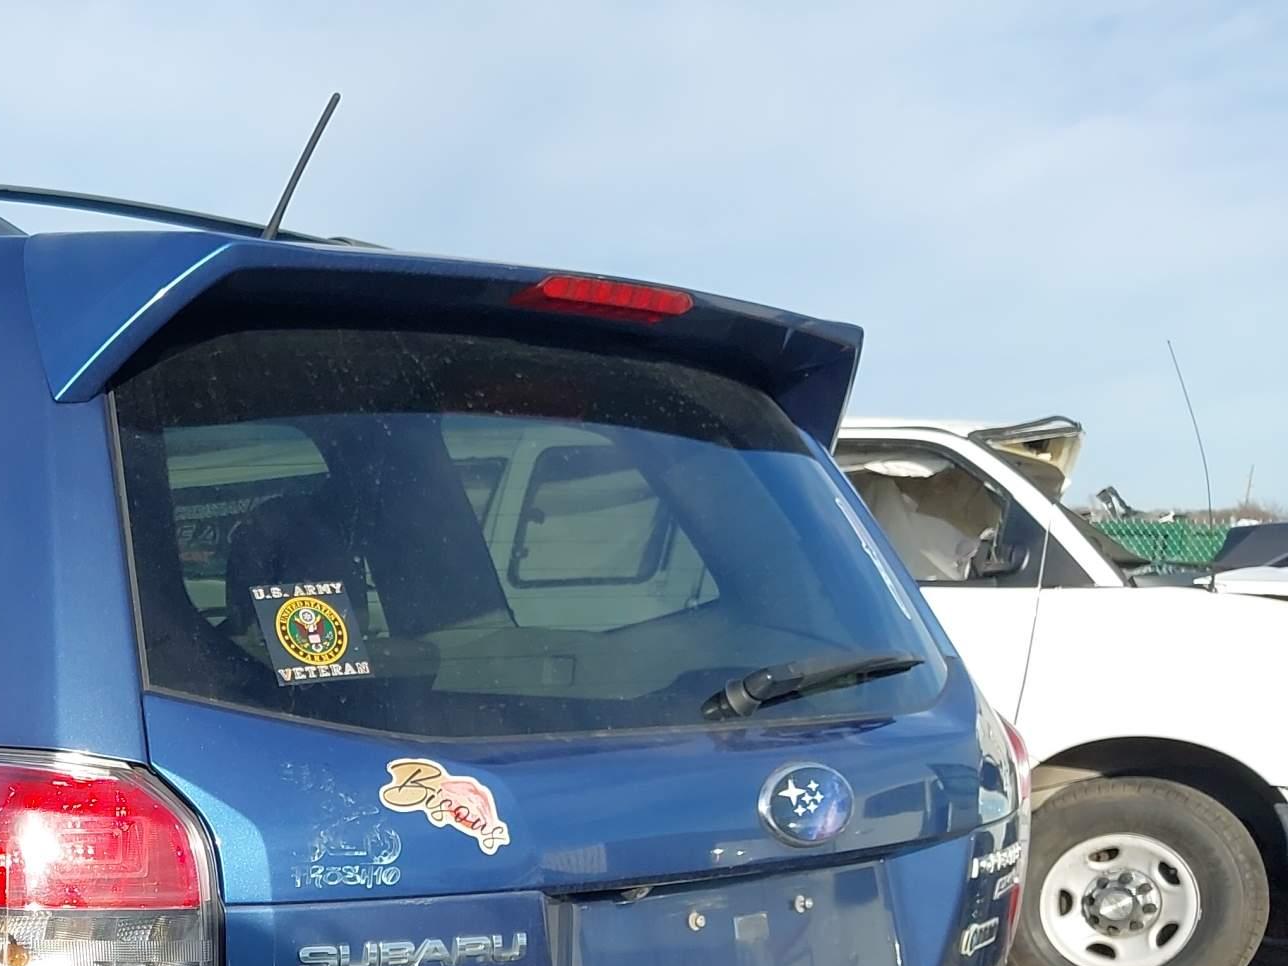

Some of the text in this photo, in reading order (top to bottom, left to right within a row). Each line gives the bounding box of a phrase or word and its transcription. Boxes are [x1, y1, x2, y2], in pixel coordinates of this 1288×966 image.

[252, 582, 342, 600] U.S. ARMY
[280, 600, 305, 624] UNITED
[278, 661, 370, 682] VETERAN
[383, 762, 507, 849] Bisous
